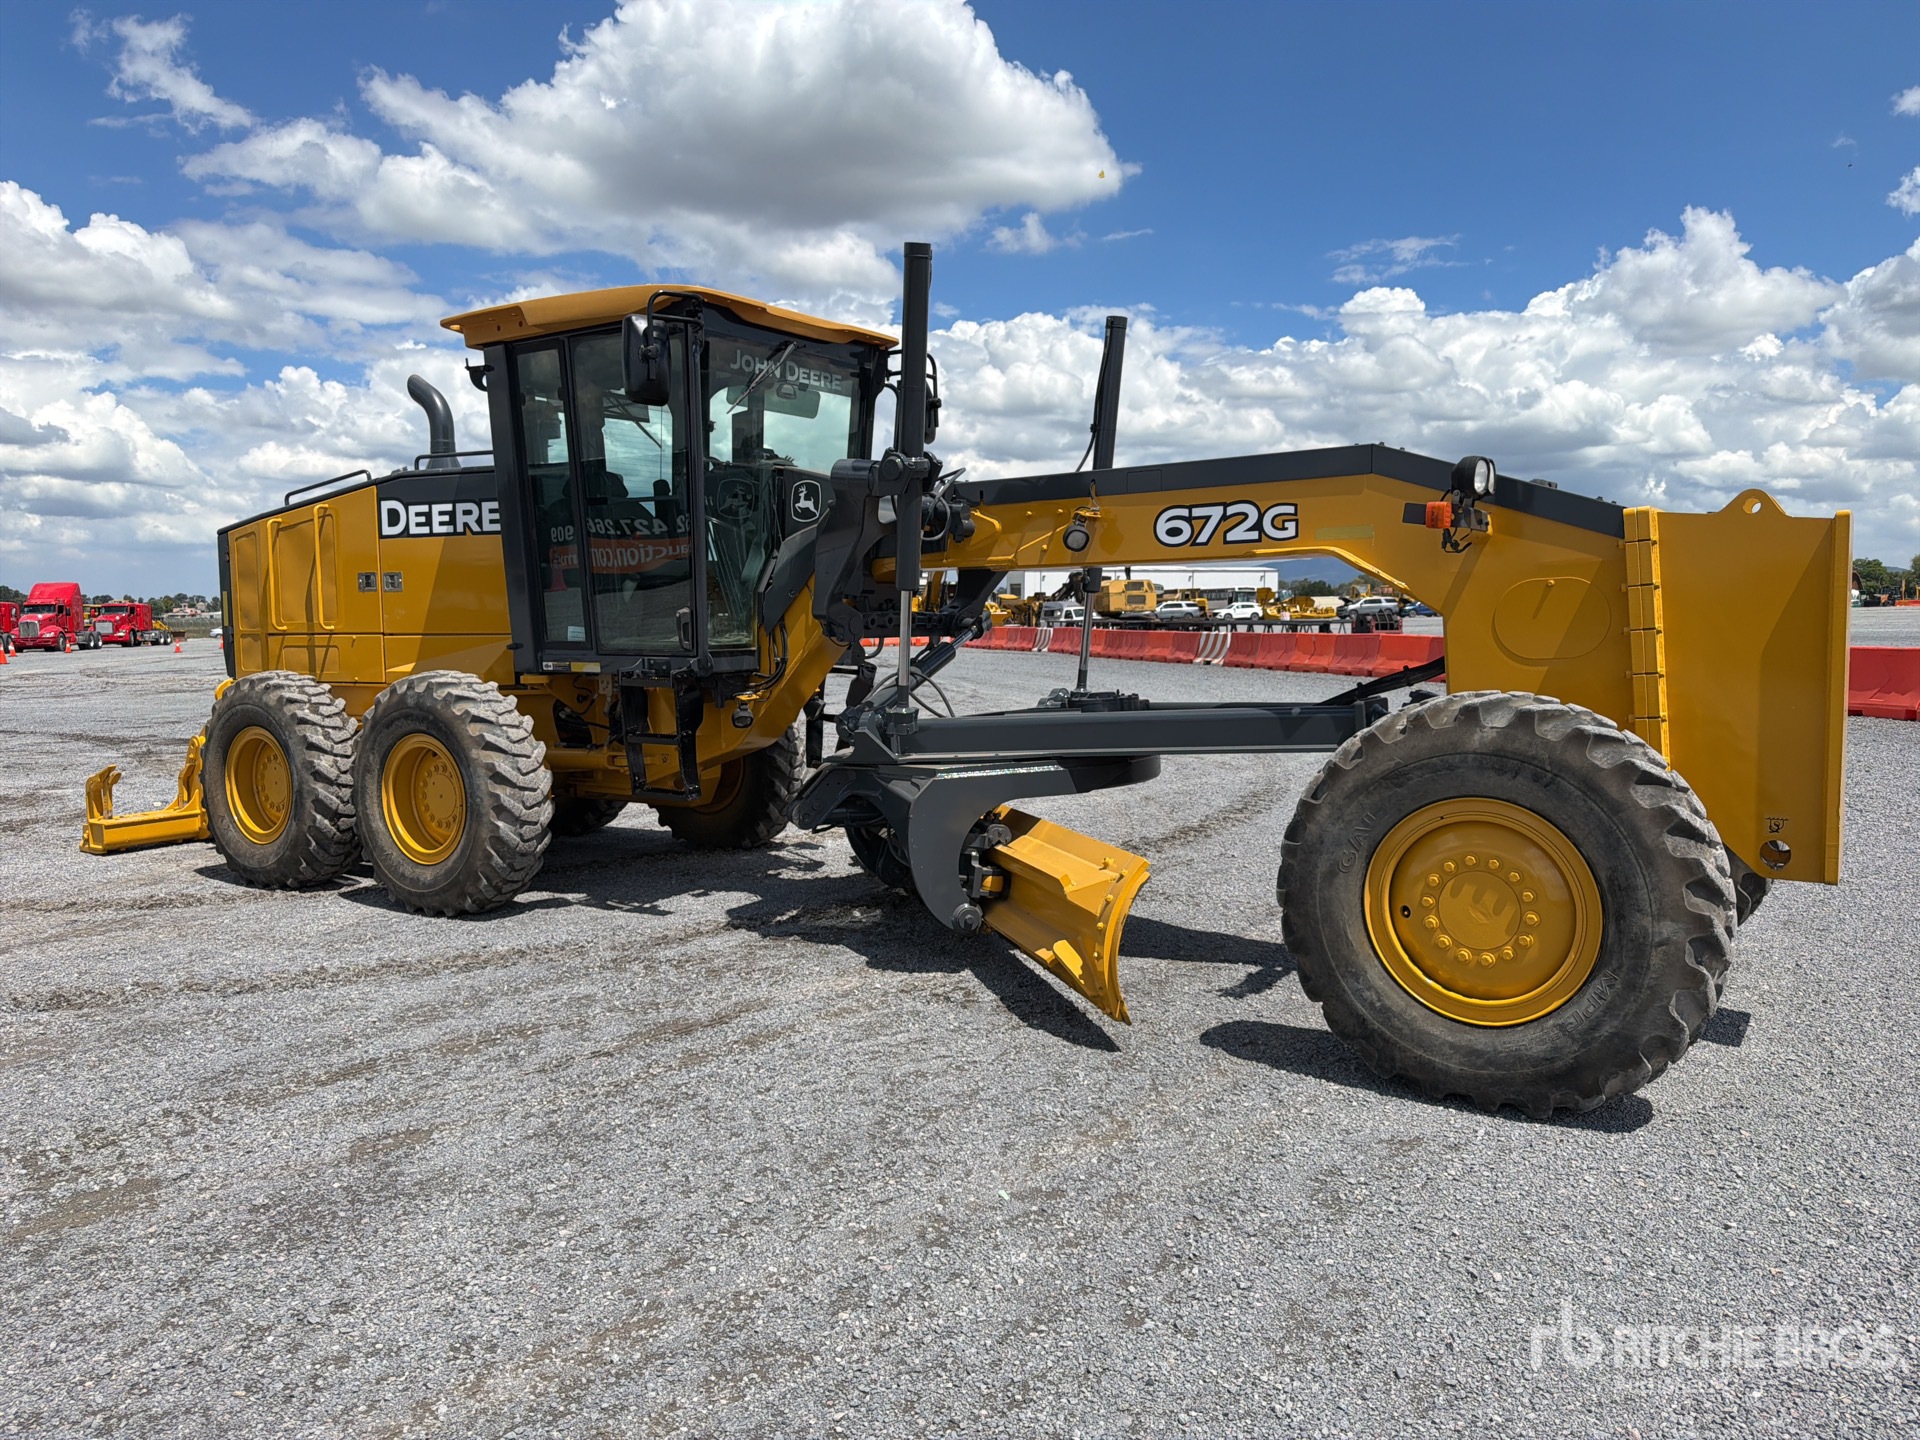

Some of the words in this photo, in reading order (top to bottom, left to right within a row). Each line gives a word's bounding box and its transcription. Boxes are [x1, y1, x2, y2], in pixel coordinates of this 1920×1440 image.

[730, 349, 782, 379] JOHN
[786, 361, 842, 391] DEERE
[380, 499, 501, 536] DEERE
[1155, 501, 1298, 546] 672G
